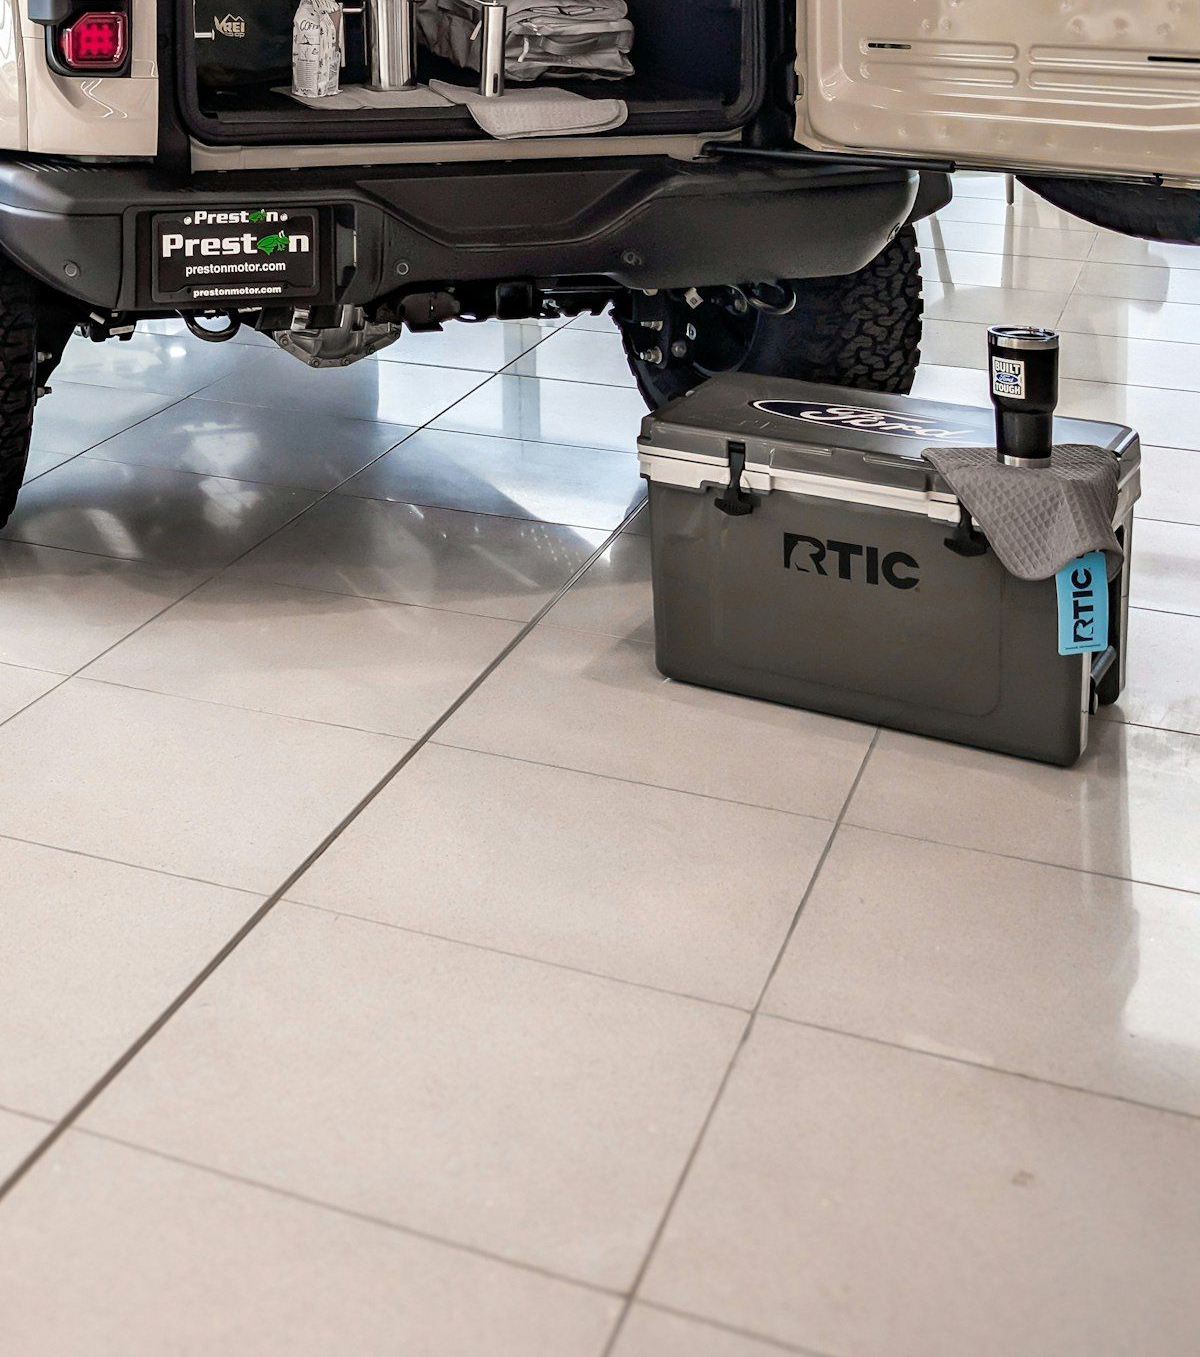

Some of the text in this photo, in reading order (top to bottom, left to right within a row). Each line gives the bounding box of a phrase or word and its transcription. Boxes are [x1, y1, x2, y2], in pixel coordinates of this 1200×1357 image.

[185, 261, 286, 278] prestonmotor.com
[192, 286, 282, 299] prestonmotor.com
[995, 360, 1021, 375] BUILT
[995, 382, 1021, 395] TOUGH
[800, 407, 975, 439] Ford
[783, 532, 921, 590] RTIC
[1071, 567, 1094, 643] RTIC
